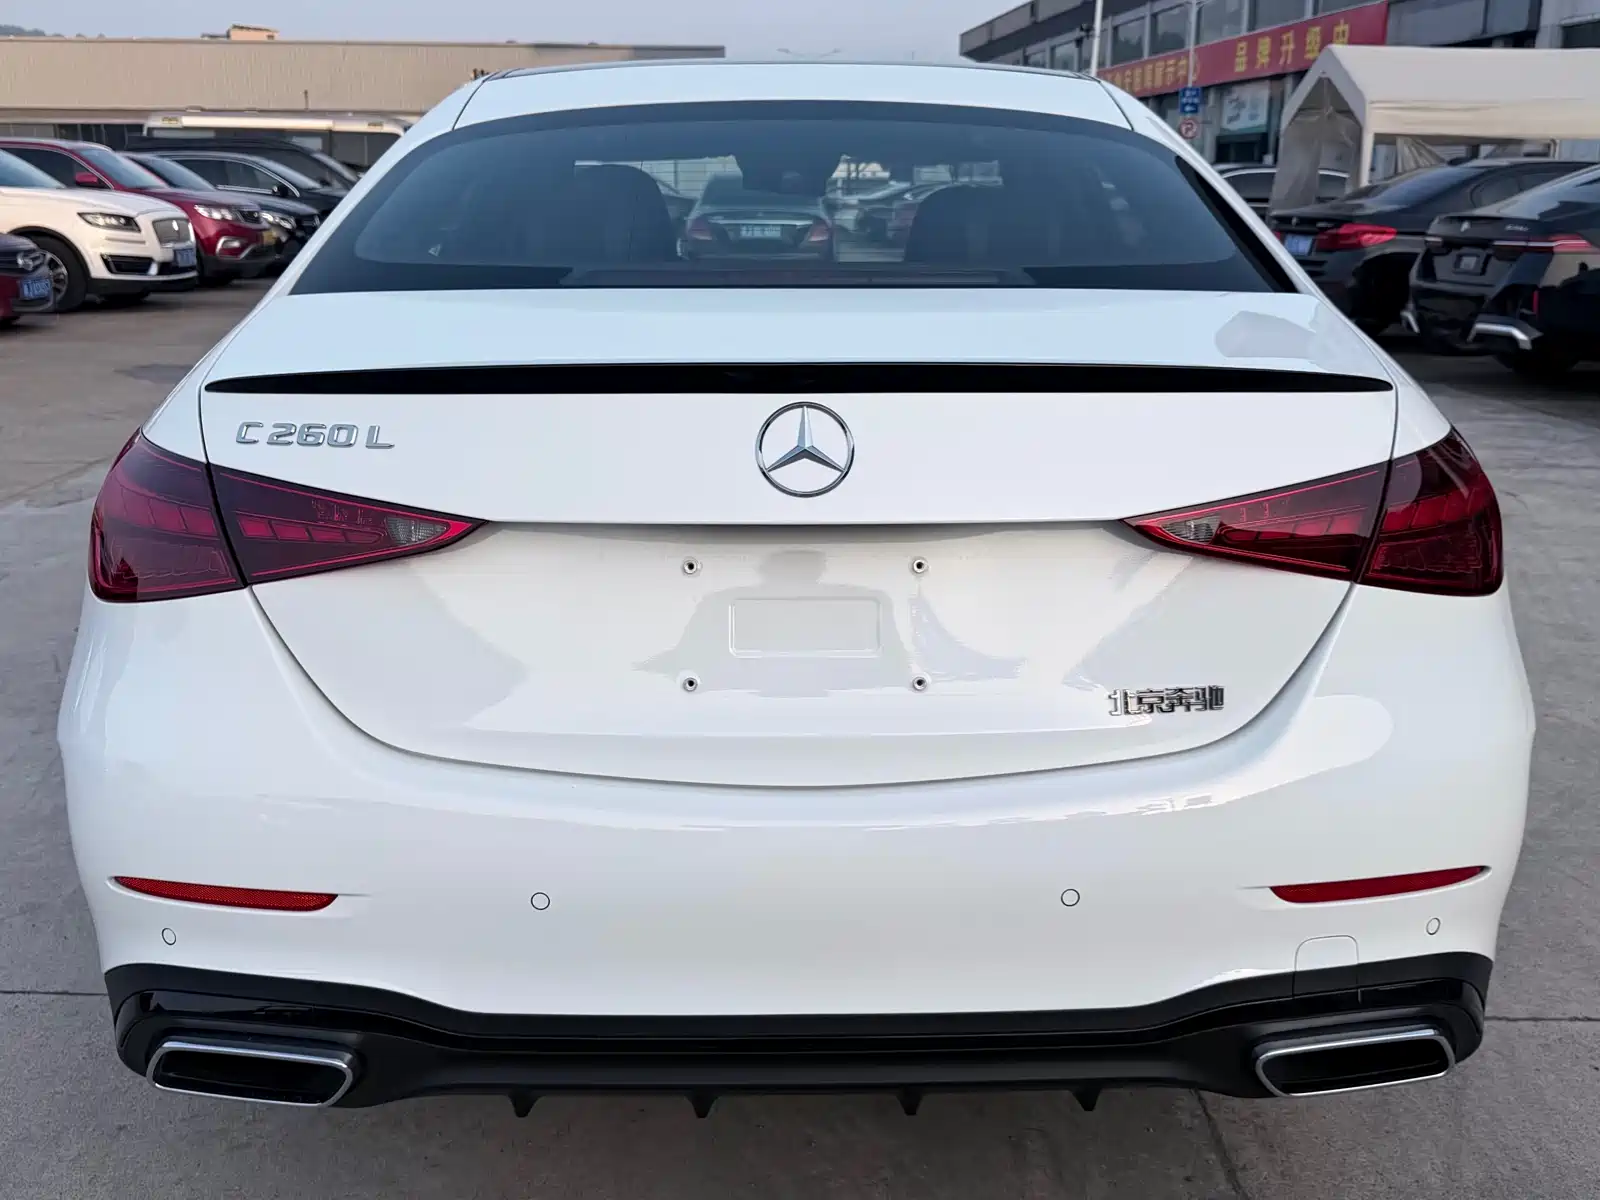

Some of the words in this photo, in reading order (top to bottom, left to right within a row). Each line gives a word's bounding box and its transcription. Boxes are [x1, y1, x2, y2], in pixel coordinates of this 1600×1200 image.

[236, 421, 264, 445] C
[266, 422, 359, 447] 260
[365, 424, 395, 449] L
[1108, 685, 1225, 716] 北京奔驰
